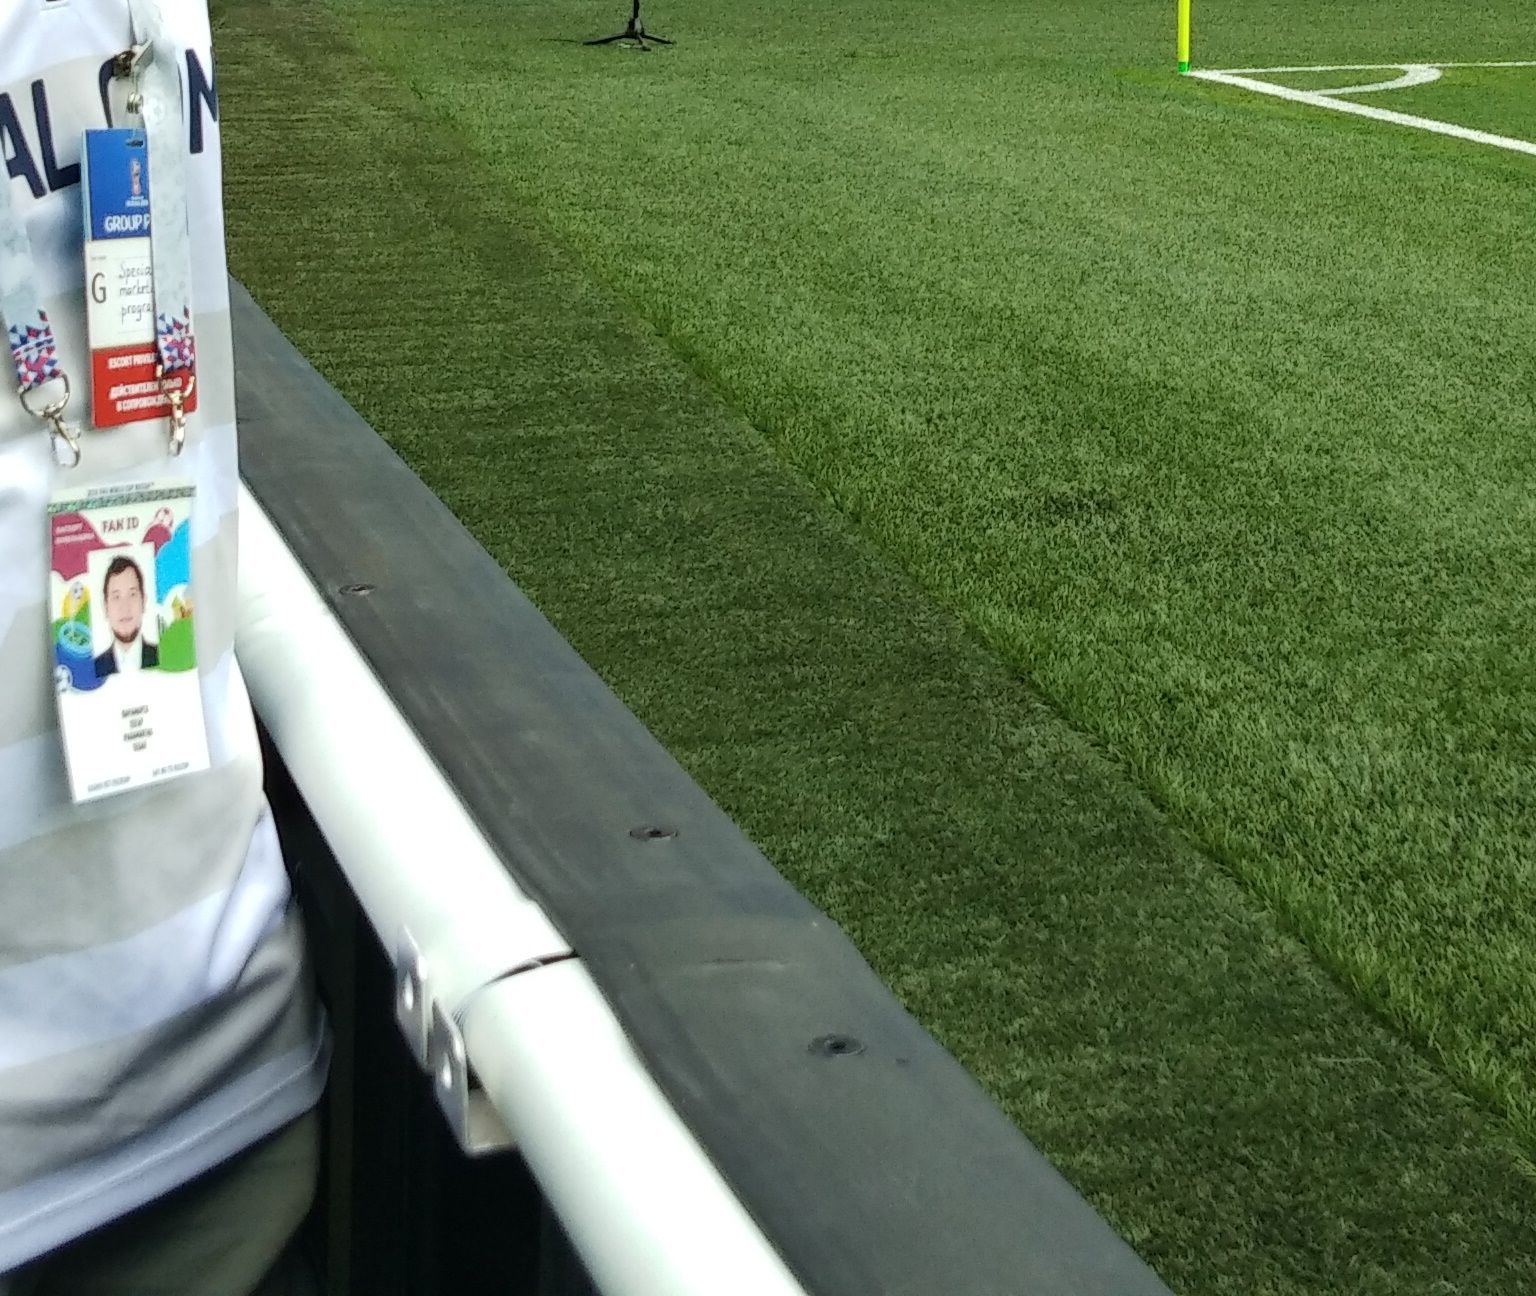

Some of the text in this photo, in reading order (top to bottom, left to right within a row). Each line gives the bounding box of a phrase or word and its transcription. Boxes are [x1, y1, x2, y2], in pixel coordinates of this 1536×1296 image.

[103, 214, 142, 232] GROUP
[118, 262, 152, 285] Specia
[91, 272, 107, 304] G
[119, 282, 154, 297] market
[121, 302, 153, 325] progra
[101, 518, 125, 534] FAN
[127, 515, 140, 530] ID
